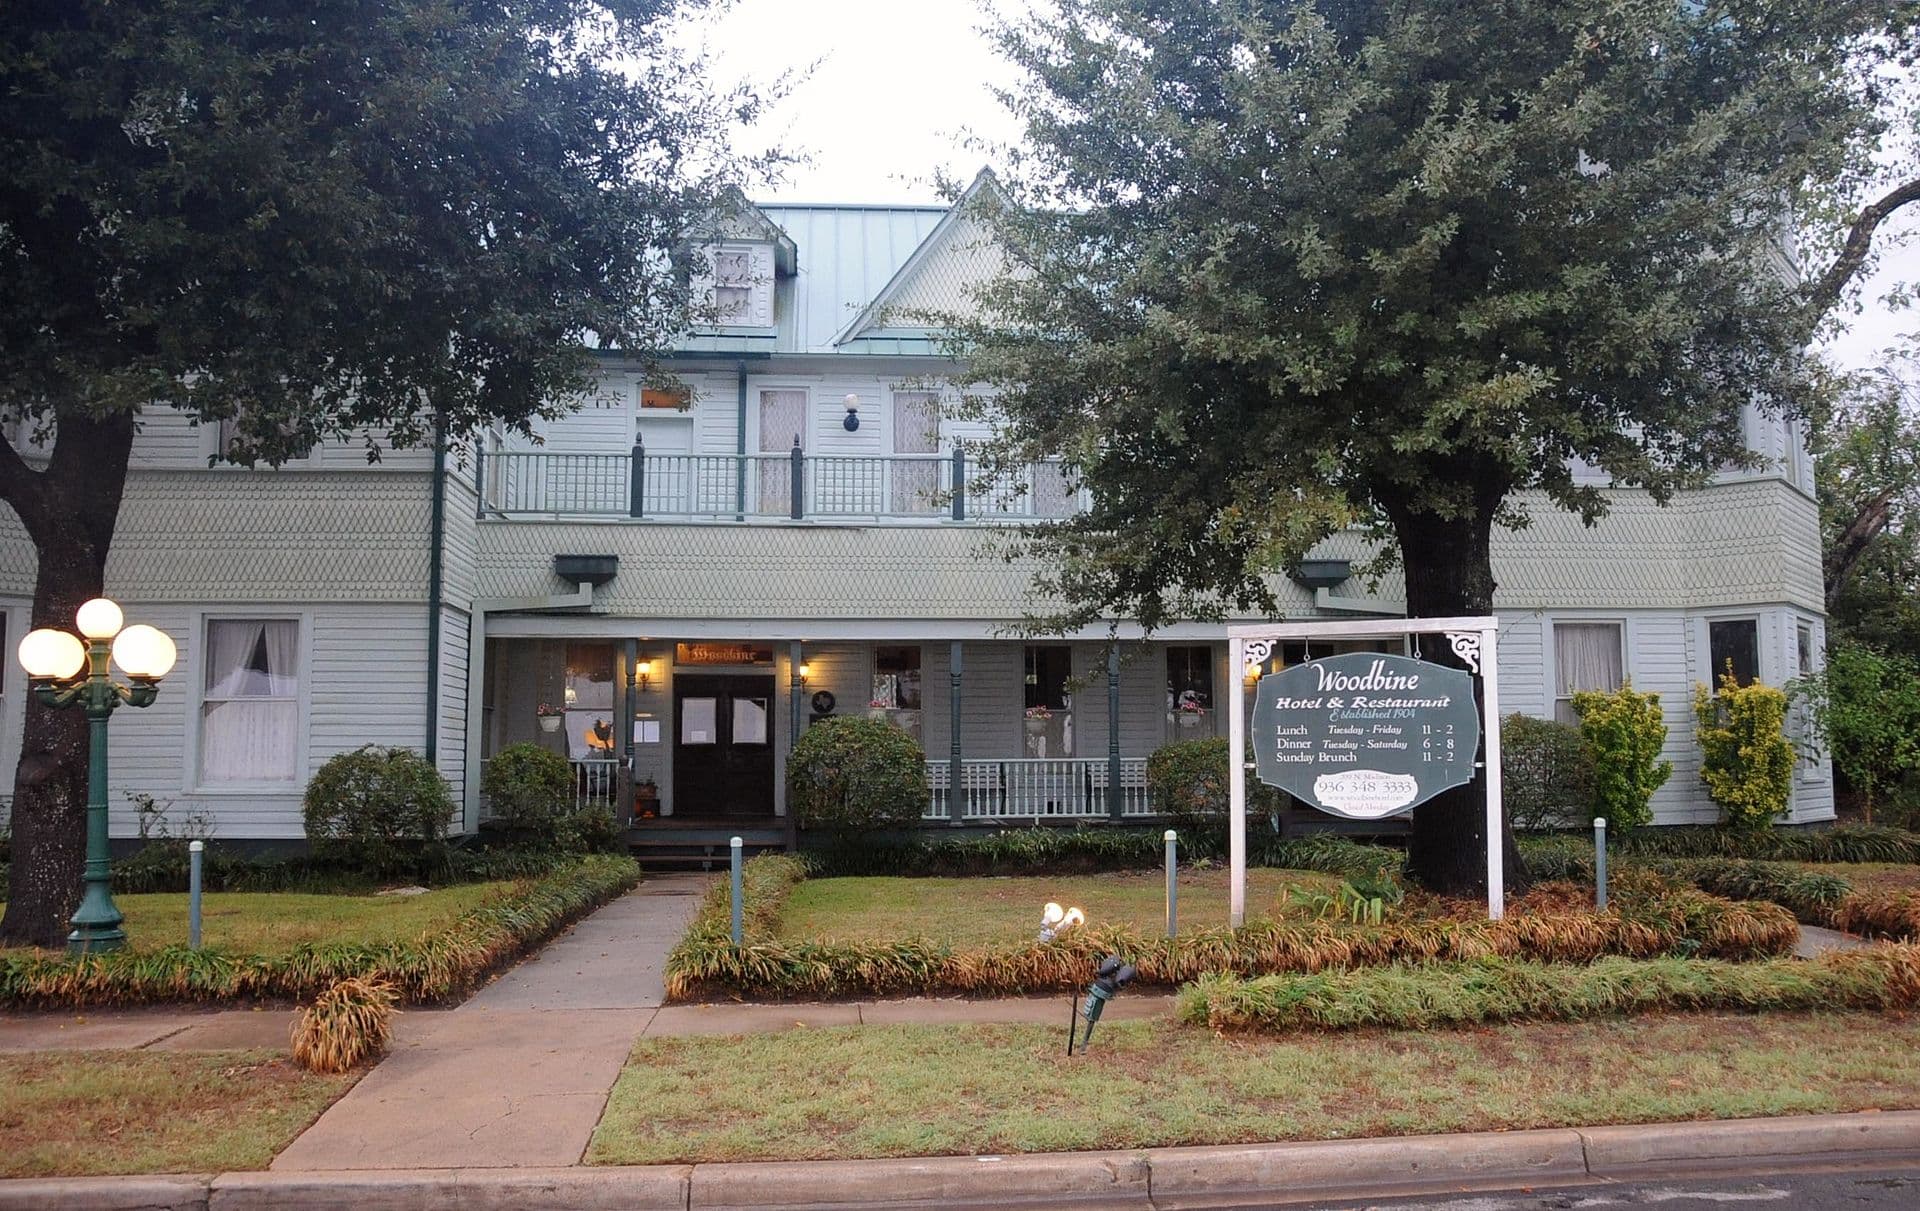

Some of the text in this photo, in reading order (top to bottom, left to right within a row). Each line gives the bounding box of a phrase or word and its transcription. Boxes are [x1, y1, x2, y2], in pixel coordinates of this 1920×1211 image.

[1310, 659, 1419, 692] Woodbine
[1275, 695, 1451, 710] Hotel & Restaurant
[1329, 708, 1416, 722] Established 1904
[1276, 724, 1308, 735] Lunch
[1328, 725, 1364, 735] Tuesday
[1372, 724, 1402, 735] Friday
[1422, 724, 1432, 735] 11
[1446, 724, 1454, 735] 2
[1276, 738, 1312, 749] Dinner
[1322, 739, 1359, 750] Tuesday
[1367, 739, 1408, 750] Saturday
[1422, 737, 1431, 749] 6
[1446, 738, 1455, 749] 8
[1276, 751, 1315, 765] Sunday
[1318, 751, 1358, 762] Brunch
[1423, 751, 1432, 762] 11
[1446, 751, 1455, 762] 2
[1319, 780, 1413, 794] 936 348 3333
